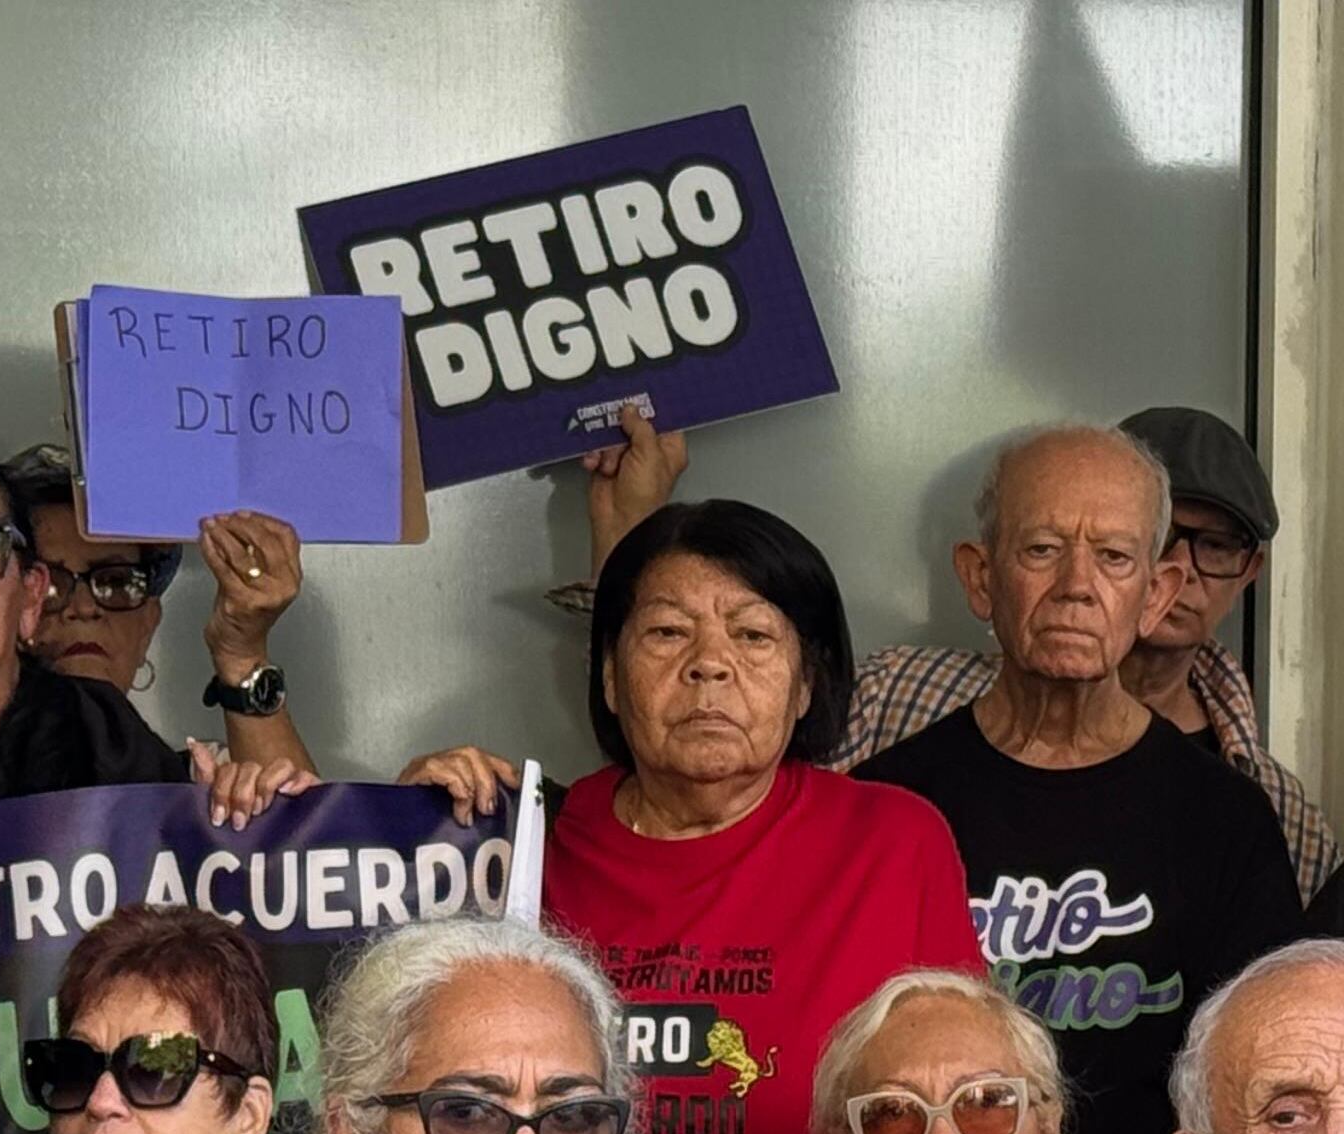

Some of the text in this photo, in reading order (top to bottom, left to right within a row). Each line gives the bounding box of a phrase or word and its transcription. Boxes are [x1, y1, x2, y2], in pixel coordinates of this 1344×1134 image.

[350, 165, 743, 316] RETIRO
[110, 306, 328, 359] RETIRO
[415, 264, 739, 409] DIGNO
[175, 386, 351, 436] DIGNO
[145, 838, 511, 929] ACUERDO
